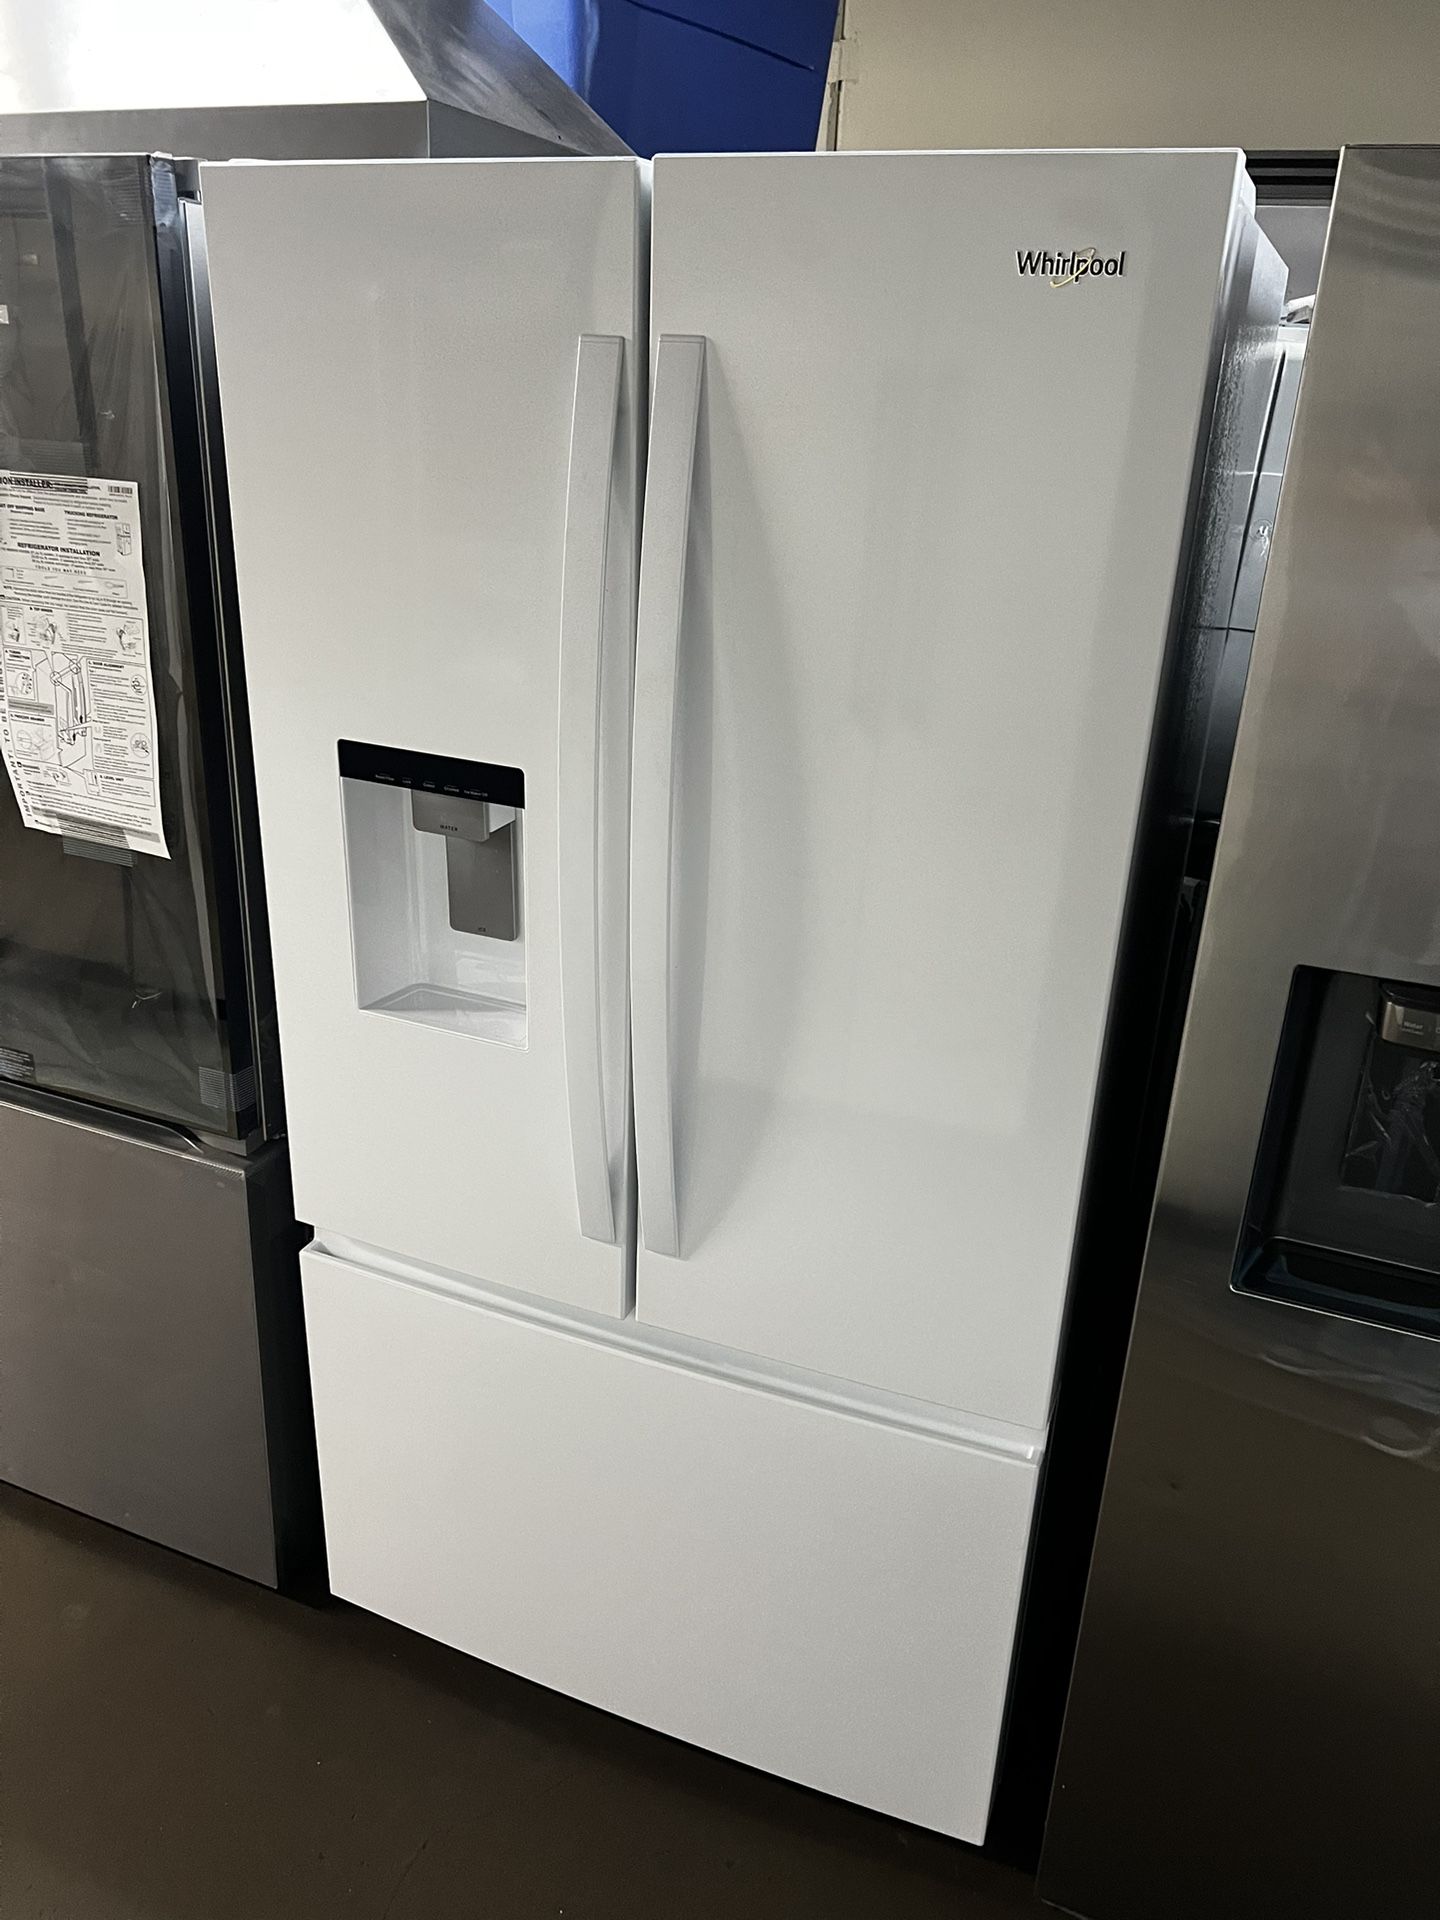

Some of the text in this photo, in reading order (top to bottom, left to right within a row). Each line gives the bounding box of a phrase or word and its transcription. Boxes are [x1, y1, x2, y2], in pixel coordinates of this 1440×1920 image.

[1015, 250, 1125, 284] Whirlpool
[17, 542, 101, 557] REFRIGERATOR INSTALLATION
